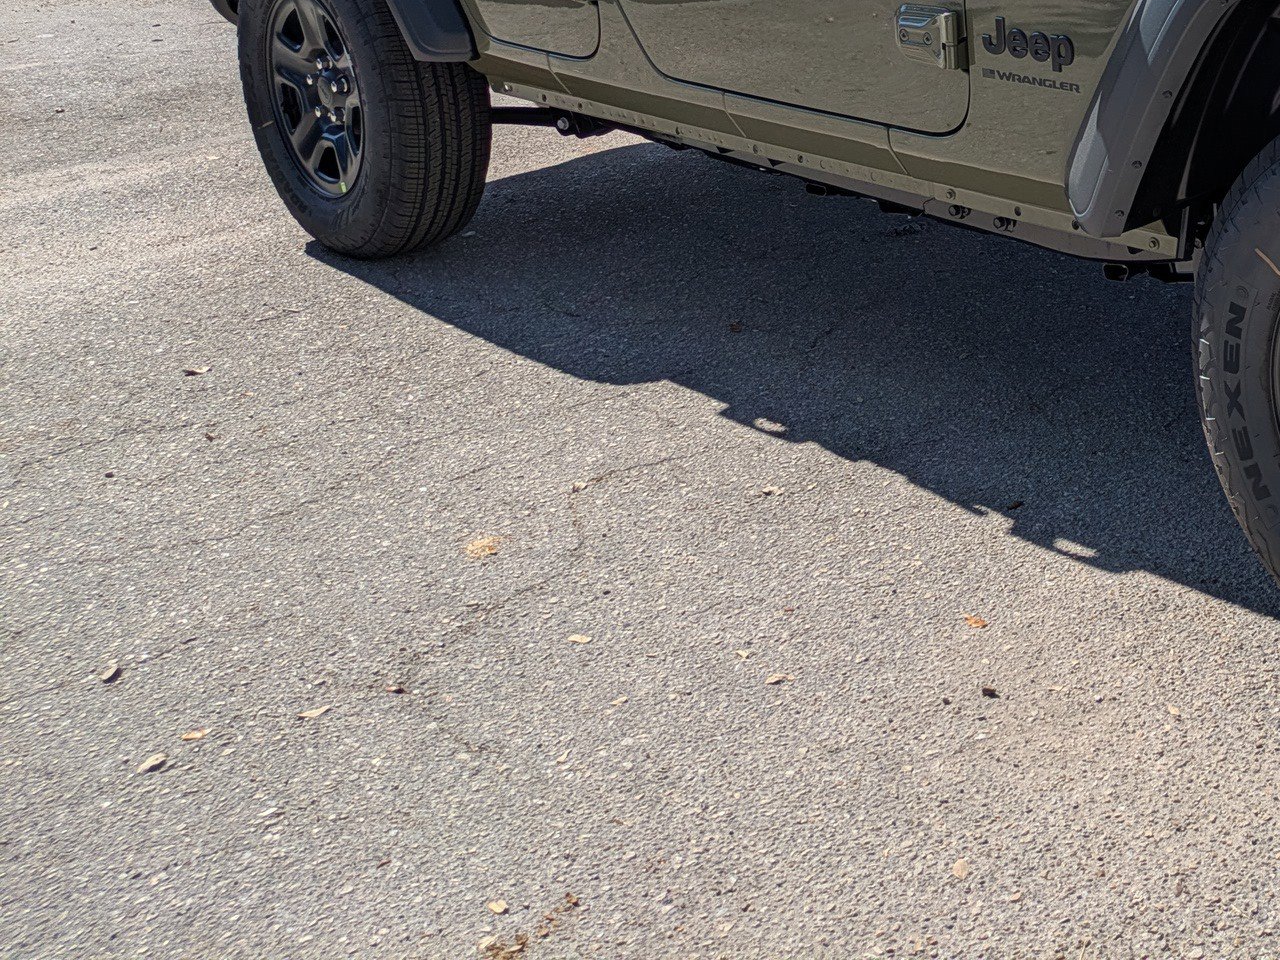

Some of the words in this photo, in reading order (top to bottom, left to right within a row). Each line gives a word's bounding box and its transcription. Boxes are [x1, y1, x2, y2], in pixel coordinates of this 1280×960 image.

[981, 15, 1075, 73] Jeep
[996, 70, 1081, 93] WRANGLER
[1223, 301, 1271, 501] NEXEN
